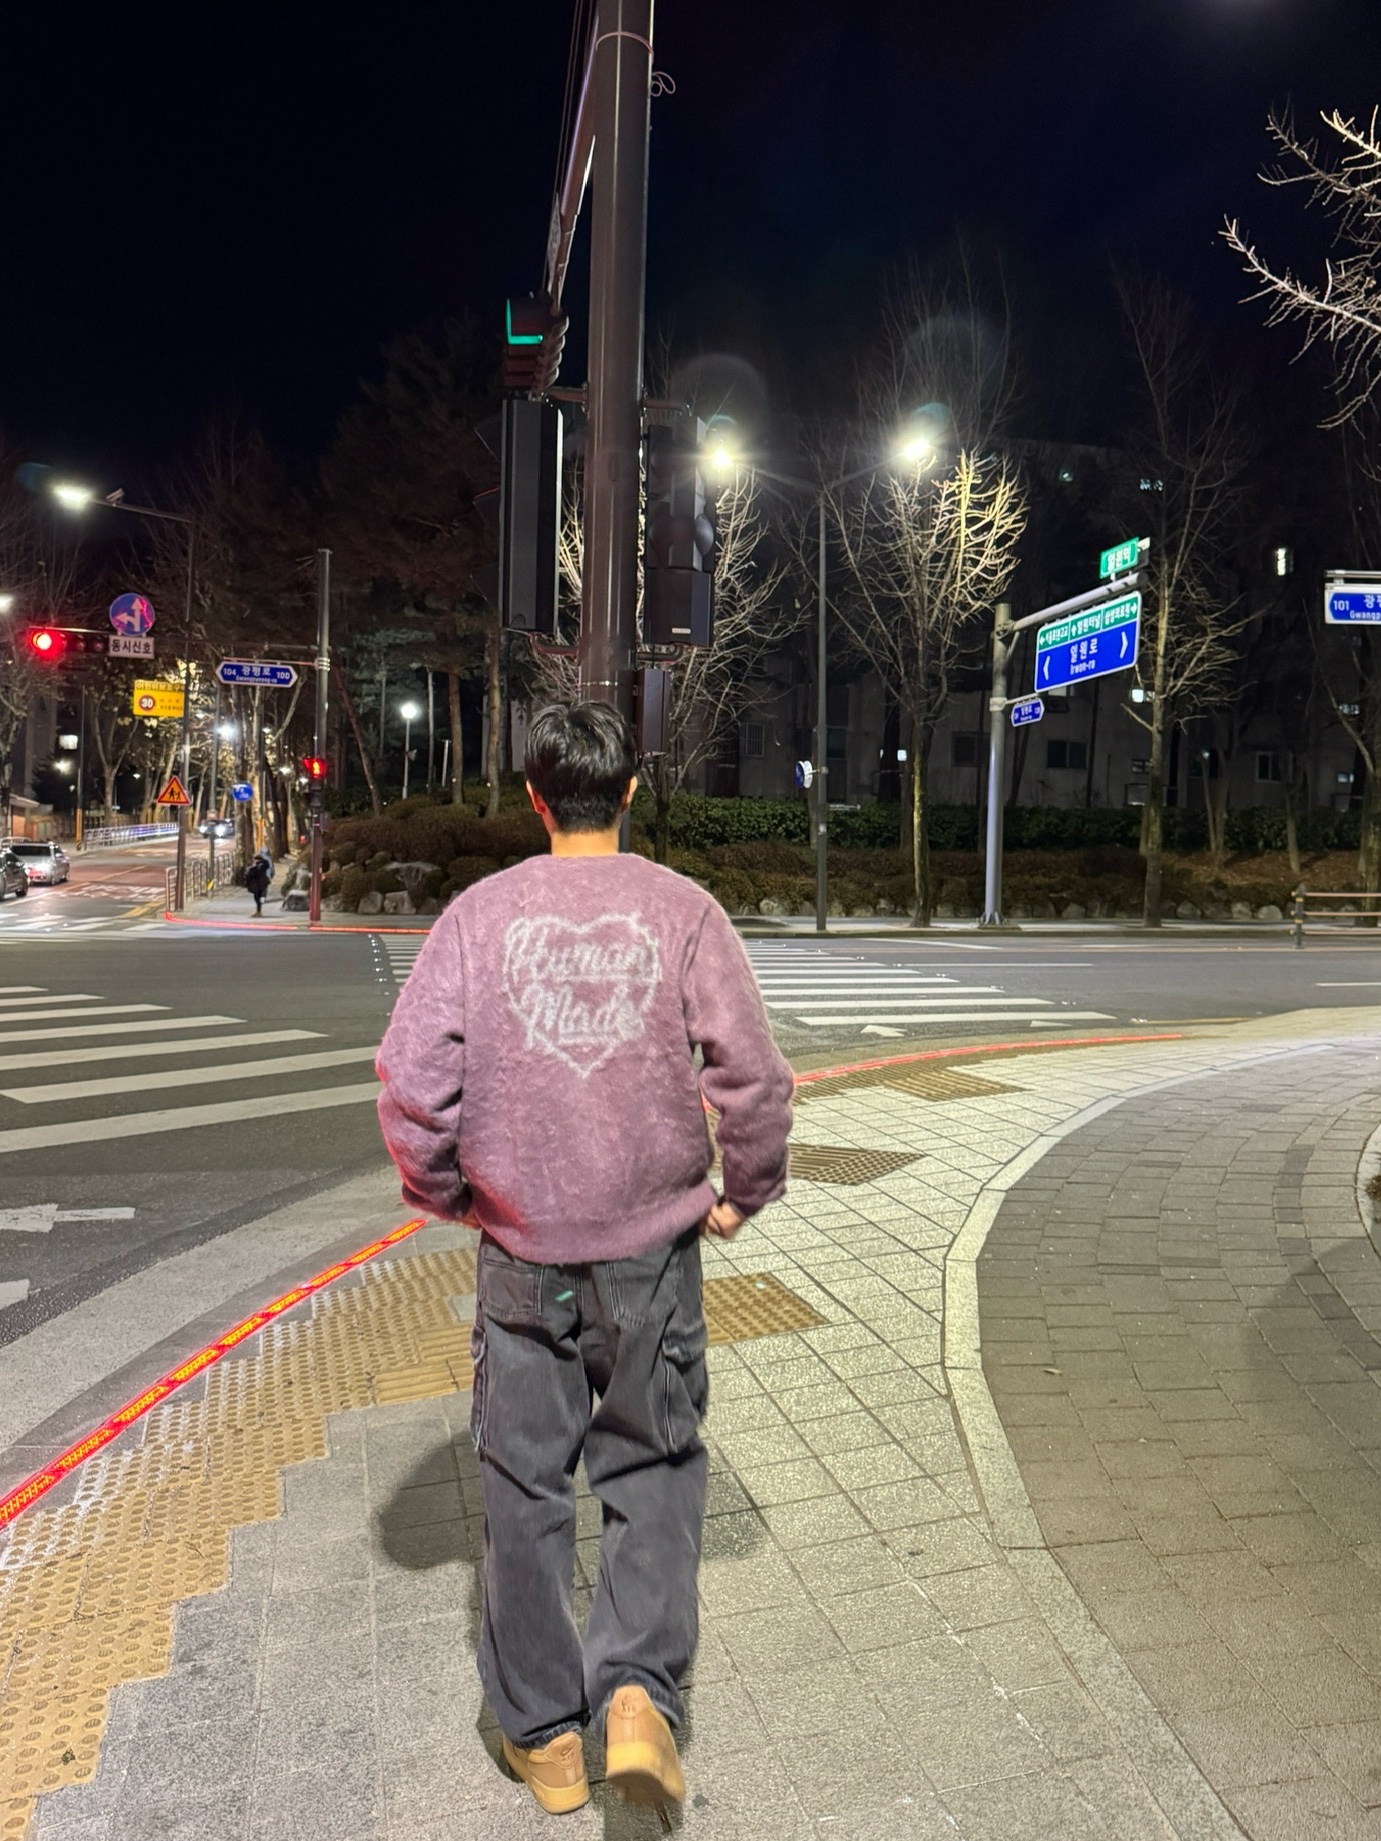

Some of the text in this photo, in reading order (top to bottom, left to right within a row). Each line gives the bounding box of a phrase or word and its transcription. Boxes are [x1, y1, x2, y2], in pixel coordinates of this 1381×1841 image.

[1333, 600, 1350, 611] 101
[112, 639, 152, 654] 동시신호
[1070, 638, 1098, 664] 일원로
[223, 666, 291, 680] 104 광평로 100
[141, 698, 154, 709] 30
